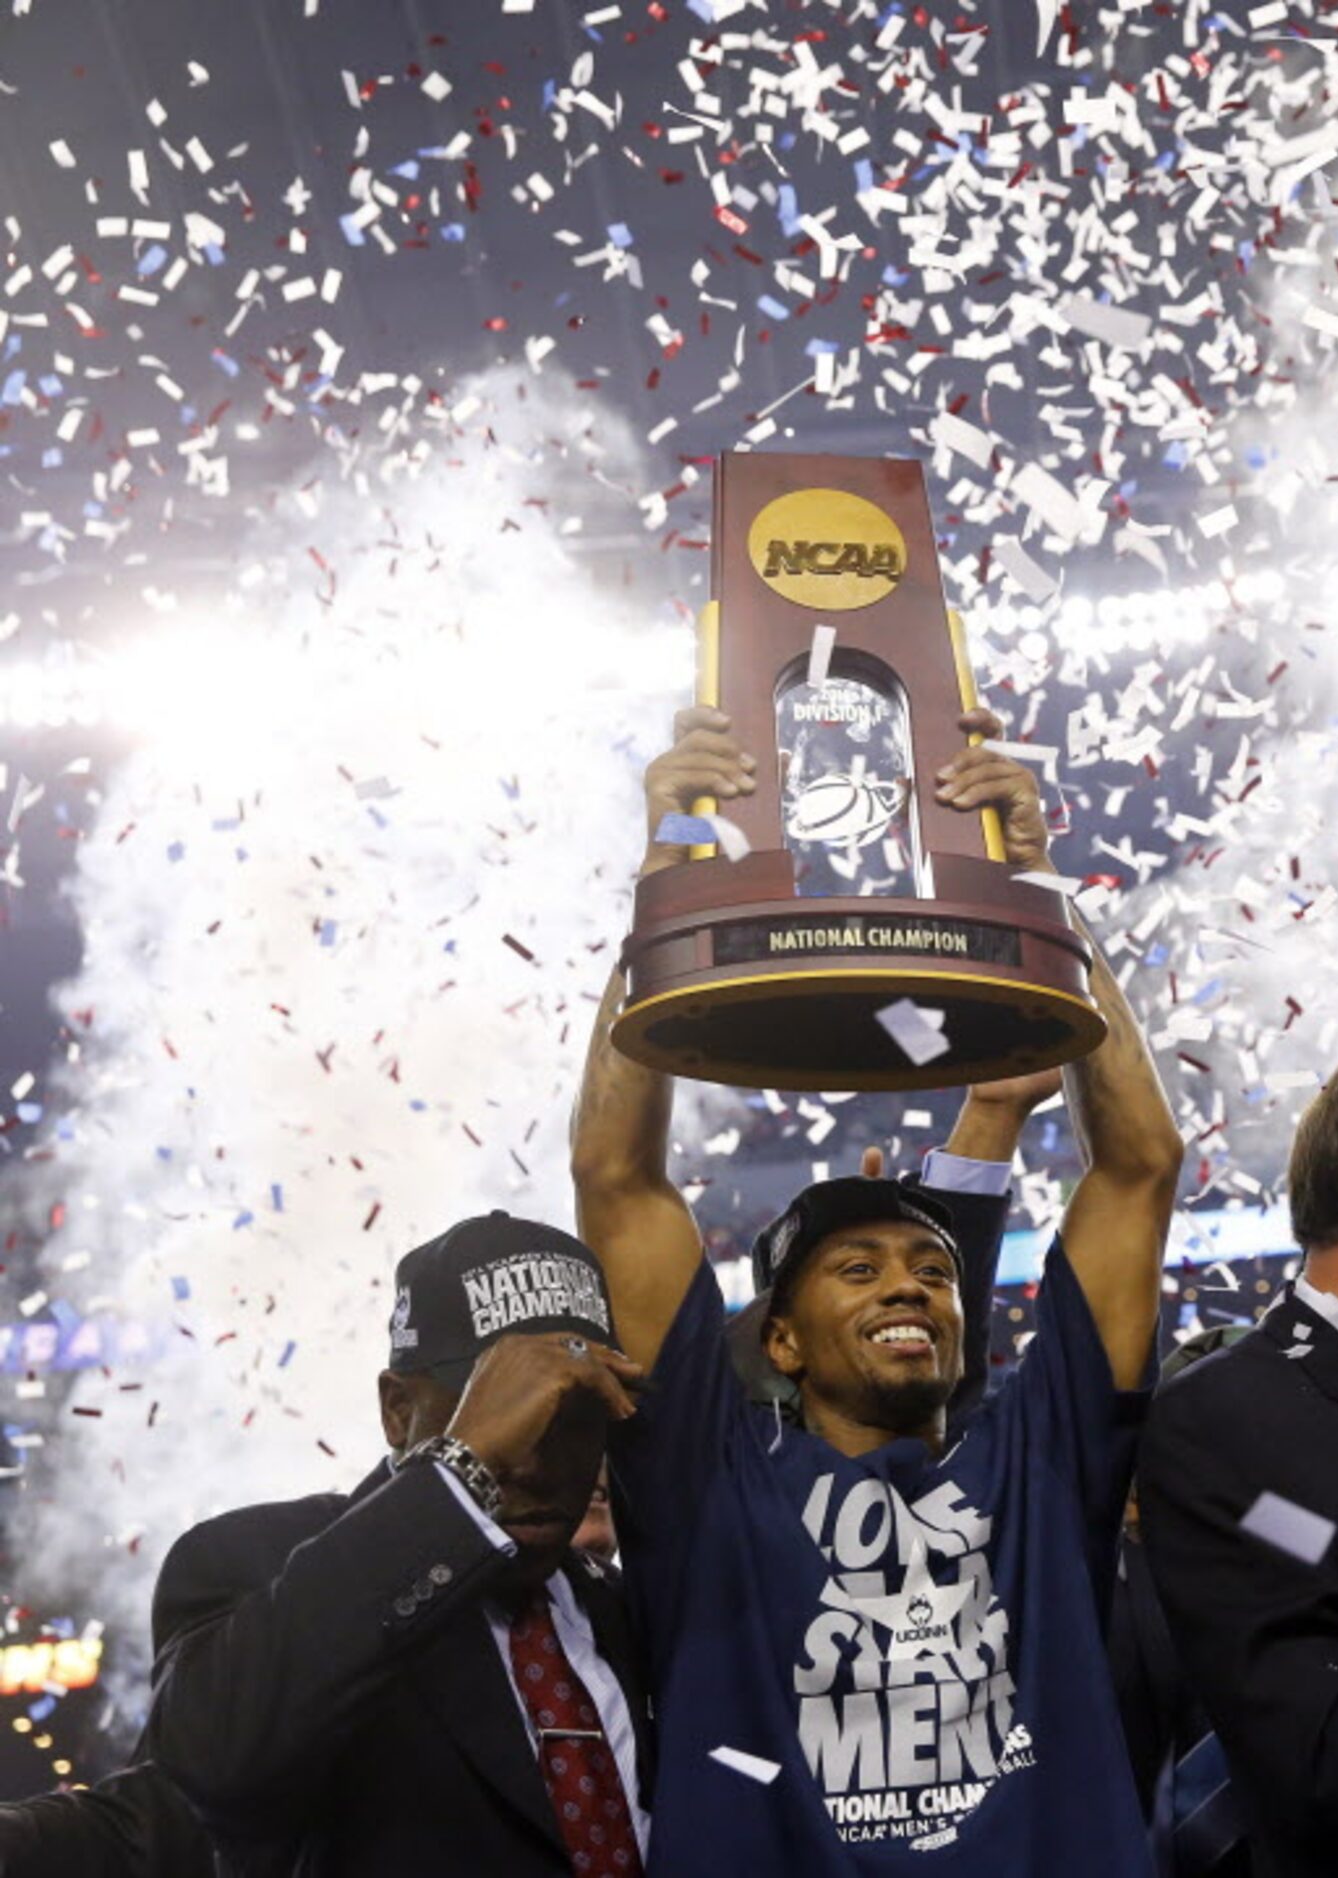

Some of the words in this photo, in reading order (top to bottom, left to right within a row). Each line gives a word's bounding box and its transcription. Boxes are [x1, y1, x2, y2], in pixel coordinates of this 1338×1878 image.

[763, 540, 902, 582] NCAA
[794, 703, 870, 722] DIVISION
[769, 929, 865, 951] NATIONAL
[868, 928, 968, 953] CHAMPION
[895, 1623, 948, 1643] UCONN
[822, 1790, 913, 1825] TIONAL
